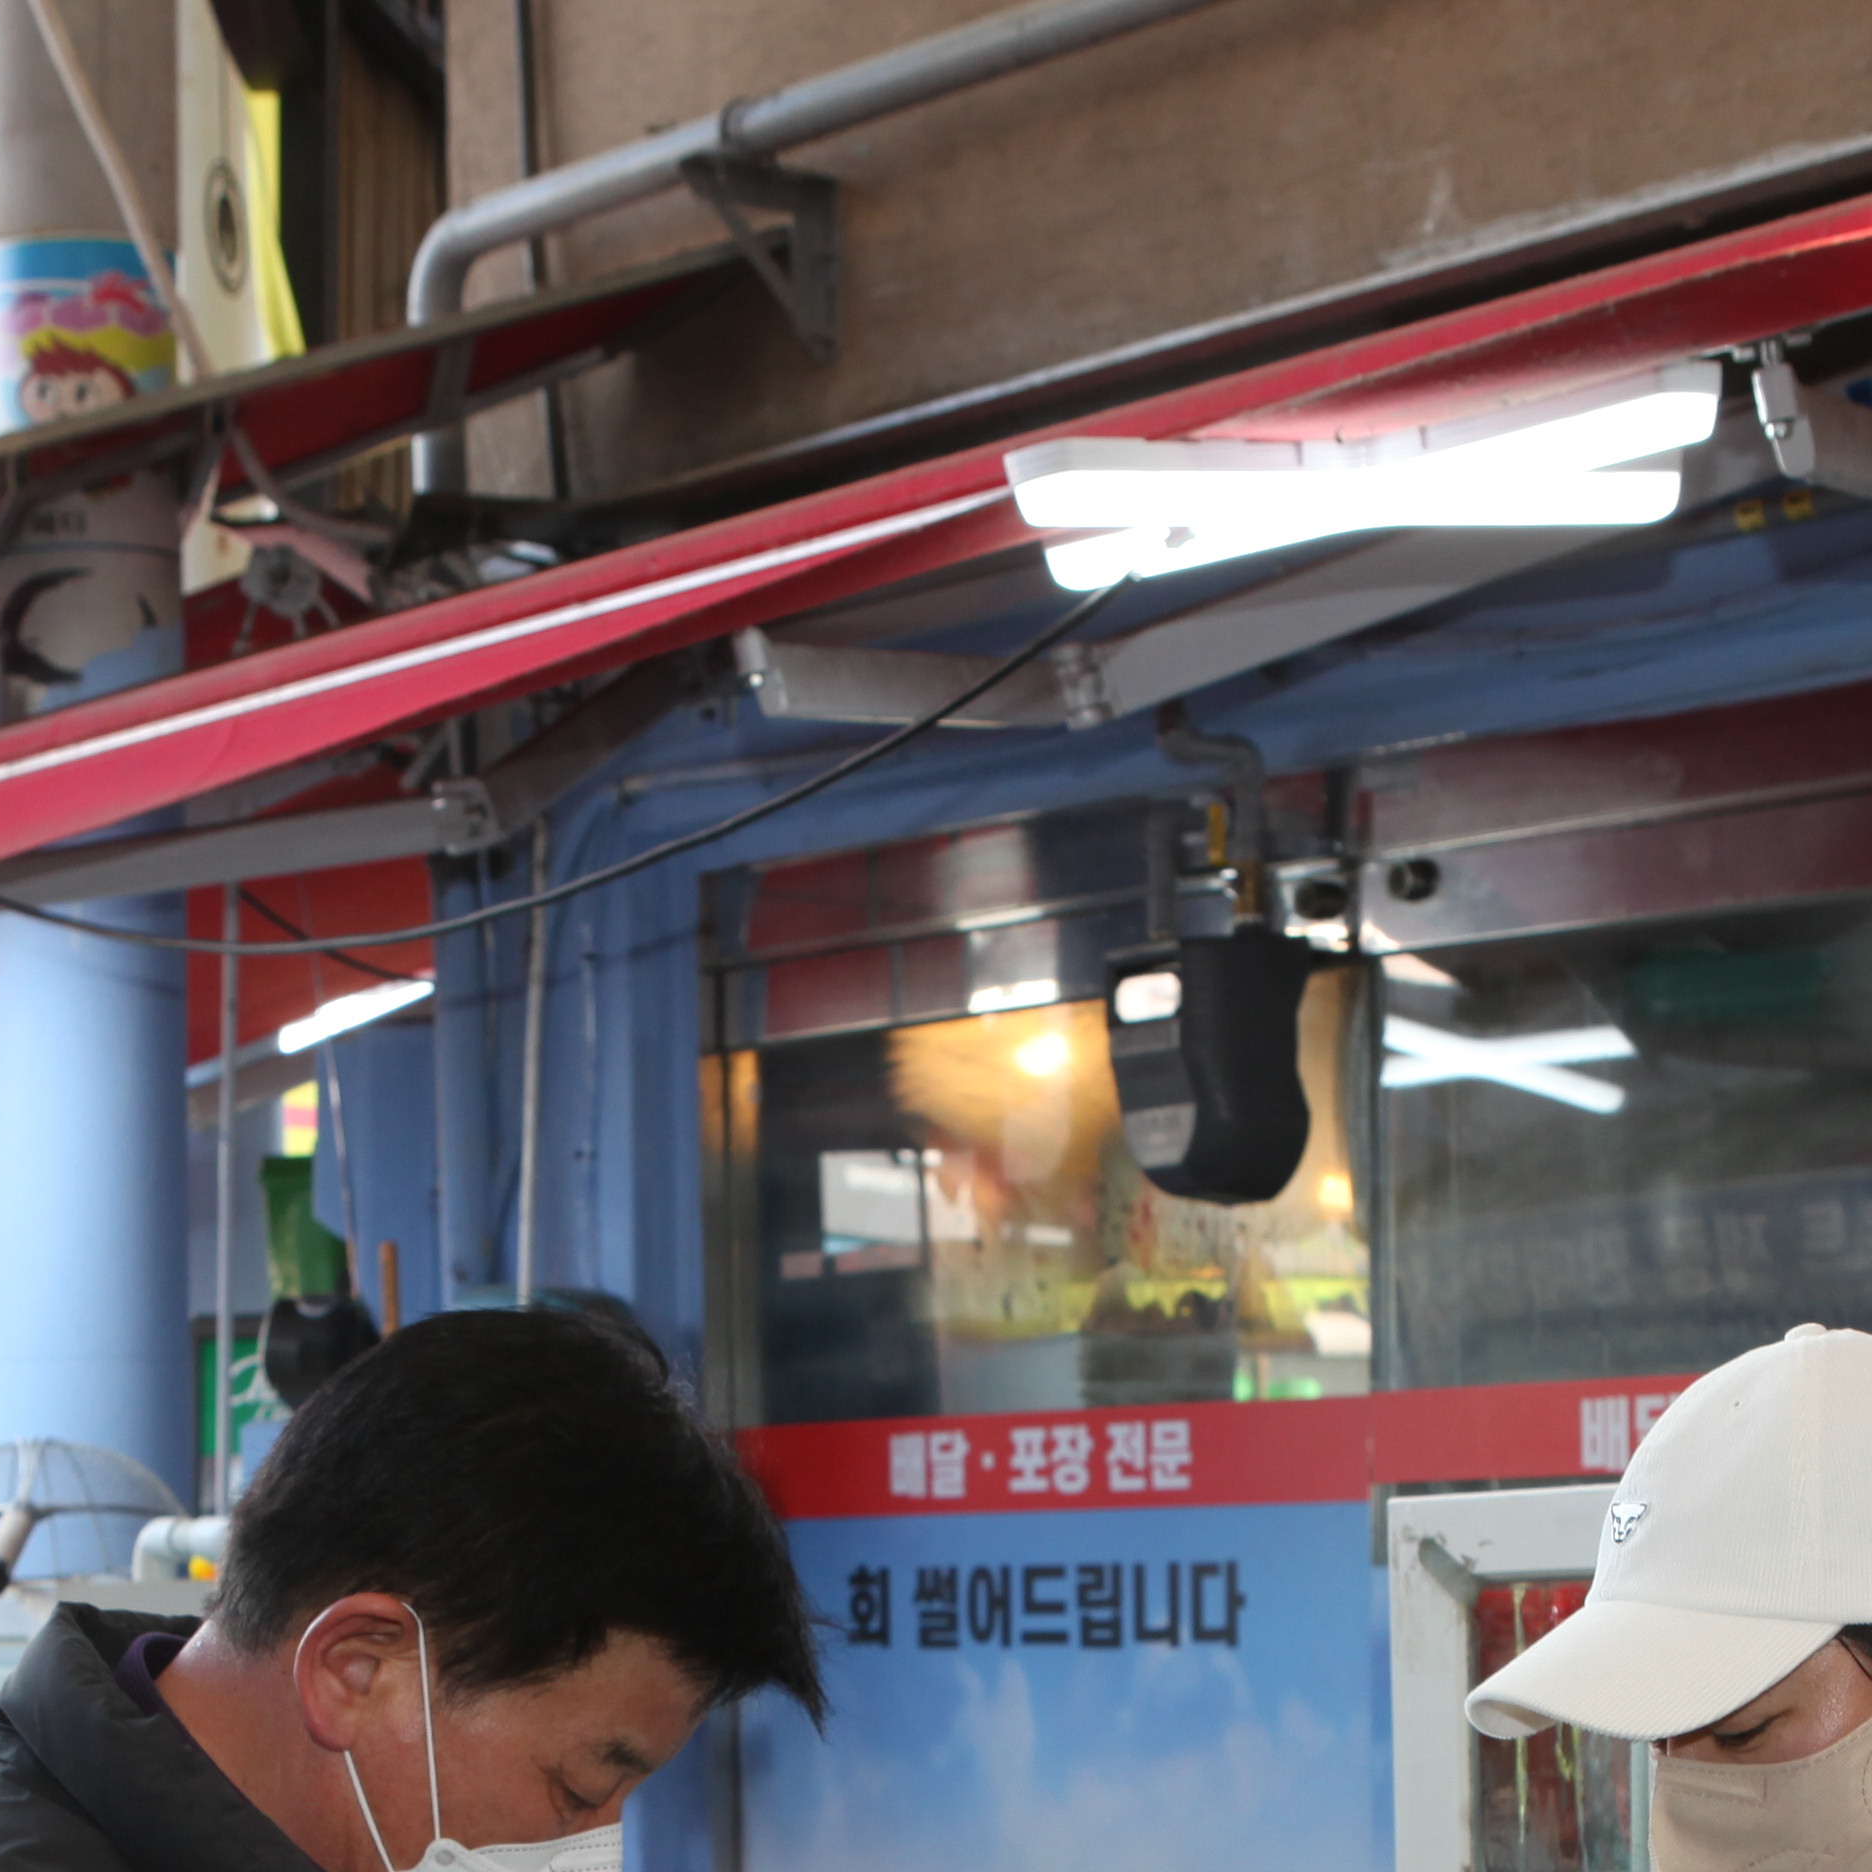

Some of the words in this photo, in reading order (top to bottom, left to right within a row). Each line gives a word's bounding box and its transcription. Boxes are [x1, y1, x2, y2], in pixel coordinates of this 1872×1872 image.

[888, 1430, 970, 1498] 배달
[1008, 1424, 1093, 1494] 포장
[1106, 1418, 1192, 1492] 전문
[847, 1564, 891, 1649] 회
[913, 1560, 1247, 1649] 썰어드립니다
